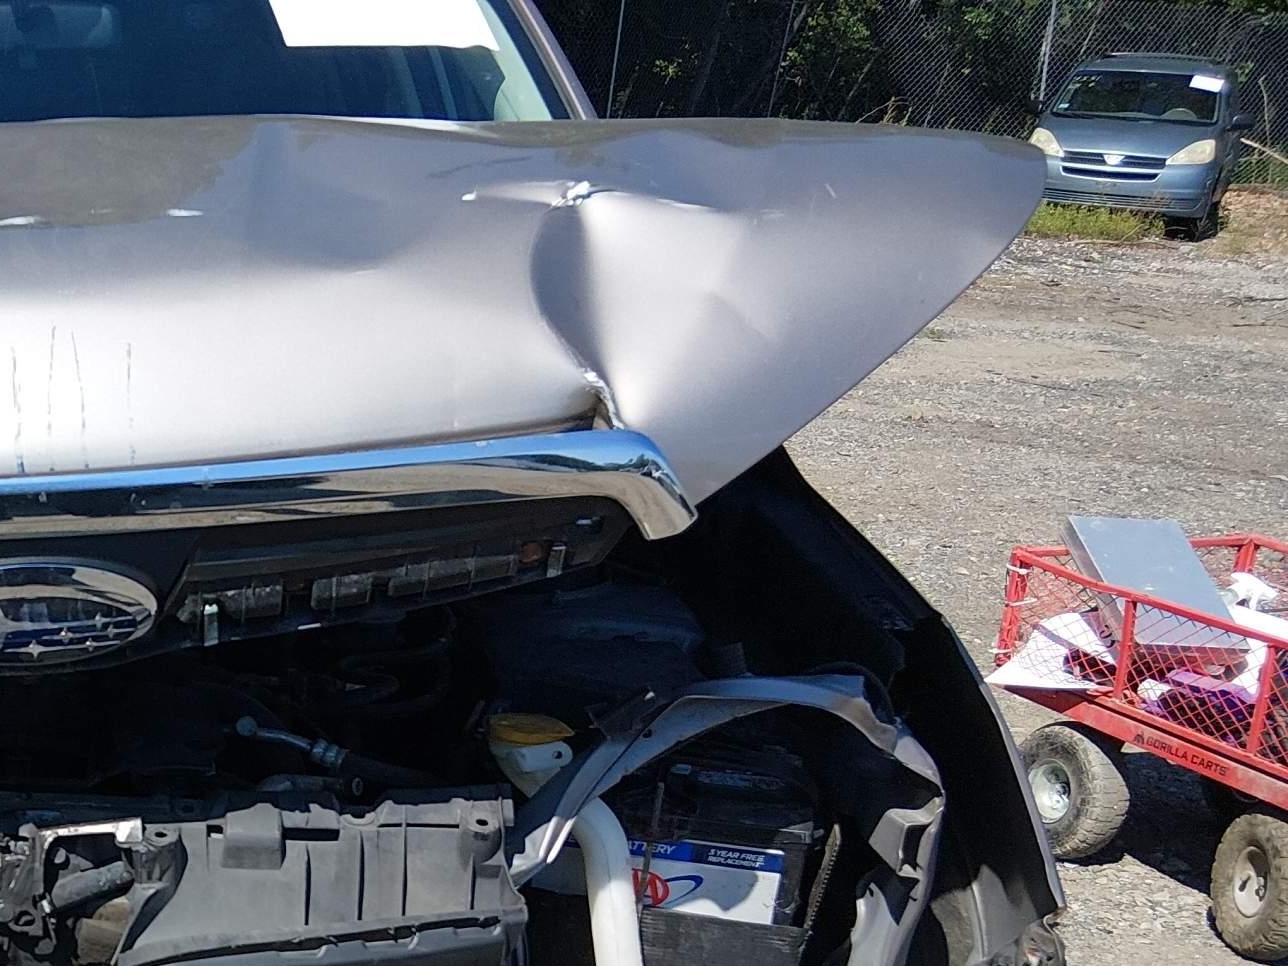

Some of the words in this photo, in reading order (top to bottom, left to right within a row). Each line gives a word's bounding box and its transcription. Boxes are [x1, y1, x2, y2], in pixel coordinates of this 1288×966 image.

[1145, 736, 1188, 761] GORILLA
[1191, 754, 1228, 776] CARTS
[716, 850, 740, 859] YEAR
[740, 853, 766, 862] FREE
